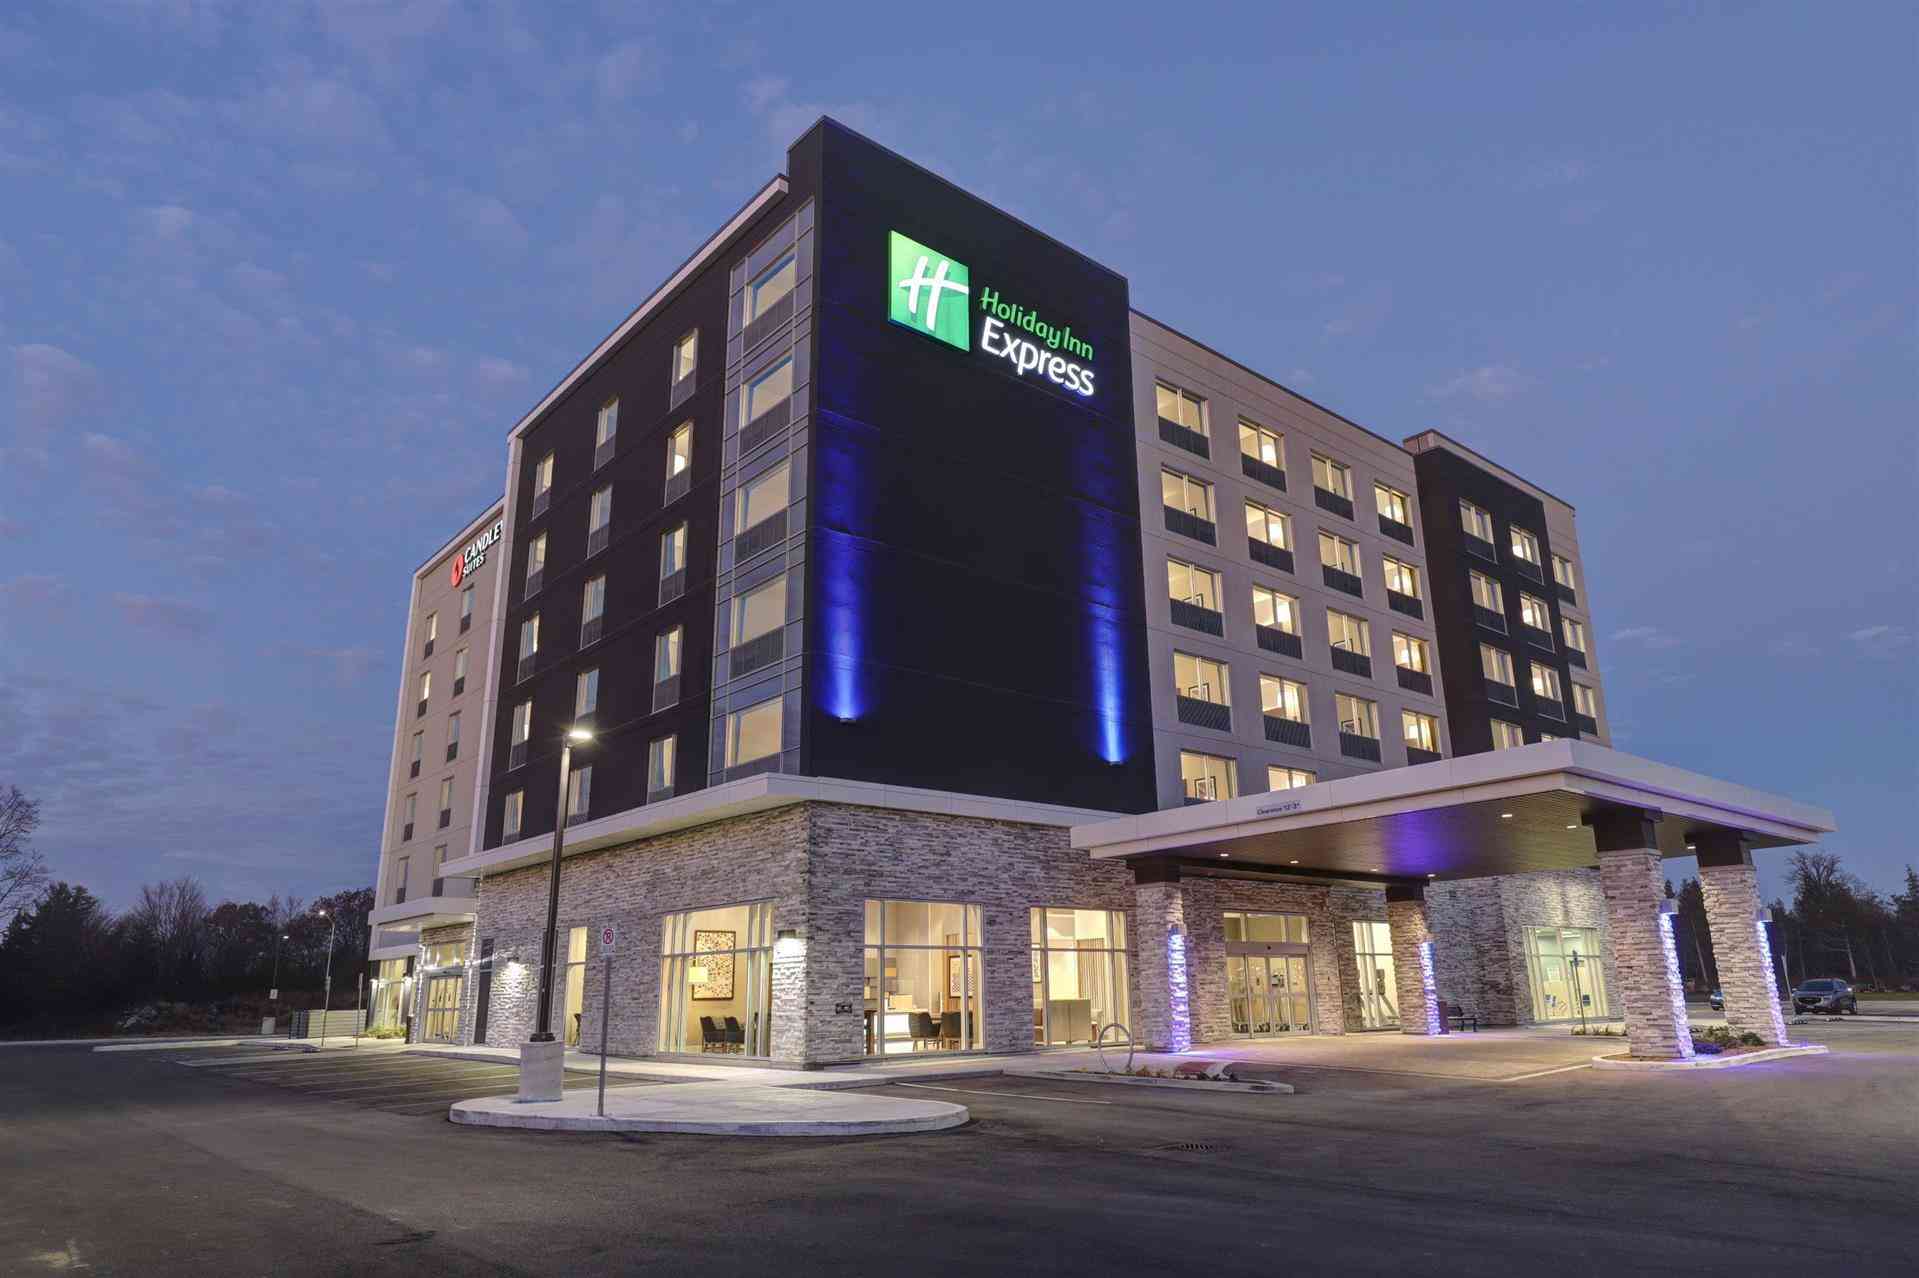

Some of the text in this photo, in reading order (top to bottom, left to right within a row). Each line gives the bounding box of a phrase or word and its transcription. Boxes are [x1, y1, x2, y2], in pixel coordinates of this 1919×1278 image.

[979, 287, 1094, 361] Holiday Inn
[981, 316, 1095, 396] Express
[462, 552, 485, 577] SUITES
[464, 520, 503, 564] CANDLE
